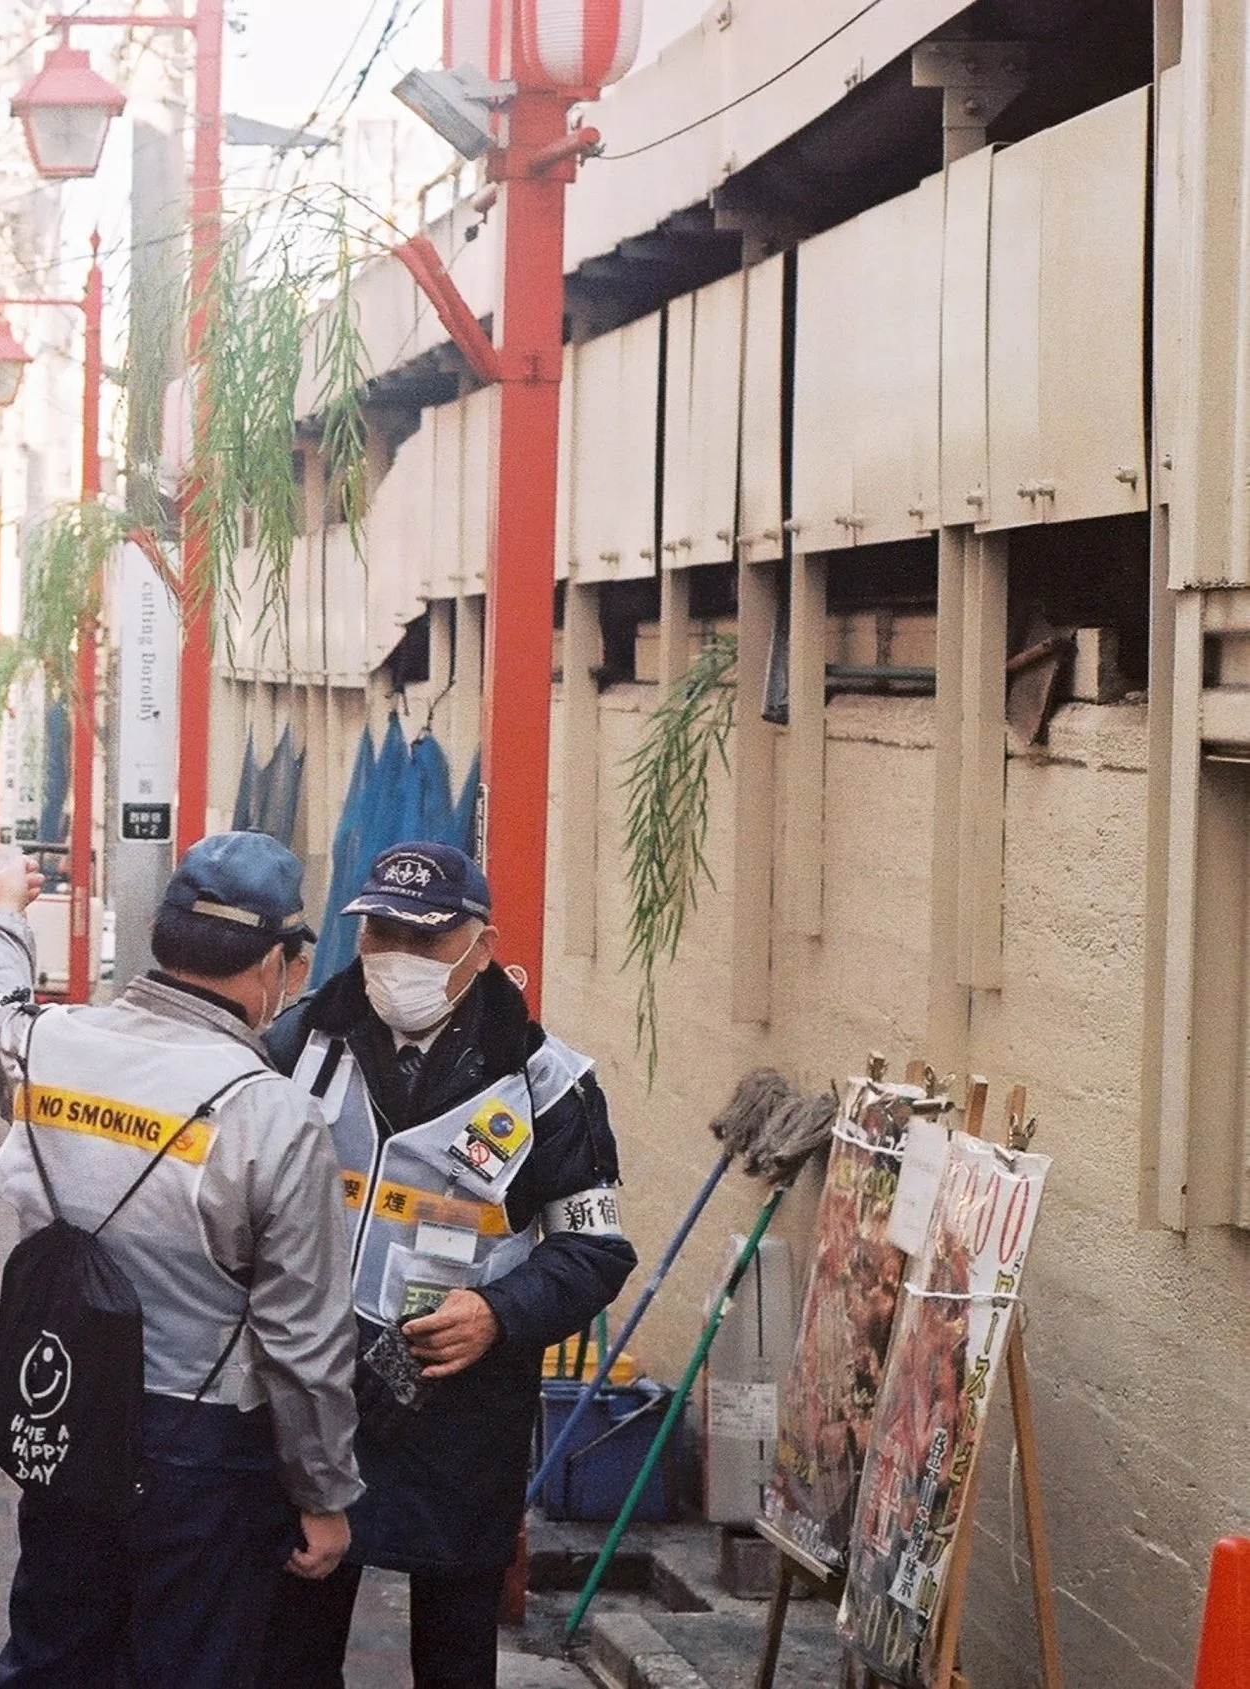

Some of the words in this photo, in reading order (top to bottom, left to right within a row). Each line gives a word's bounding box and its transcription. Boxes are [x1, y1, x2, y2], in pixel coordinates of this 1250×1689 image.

[37, 1095, 63, 1118] NO
[66, 1101, 162, 1143] SMOKING
[563, 1195, 617, 1231] 新宿
[58, 1424, 70, 1442] A
[15, 1460, 57, 1486] DAY
